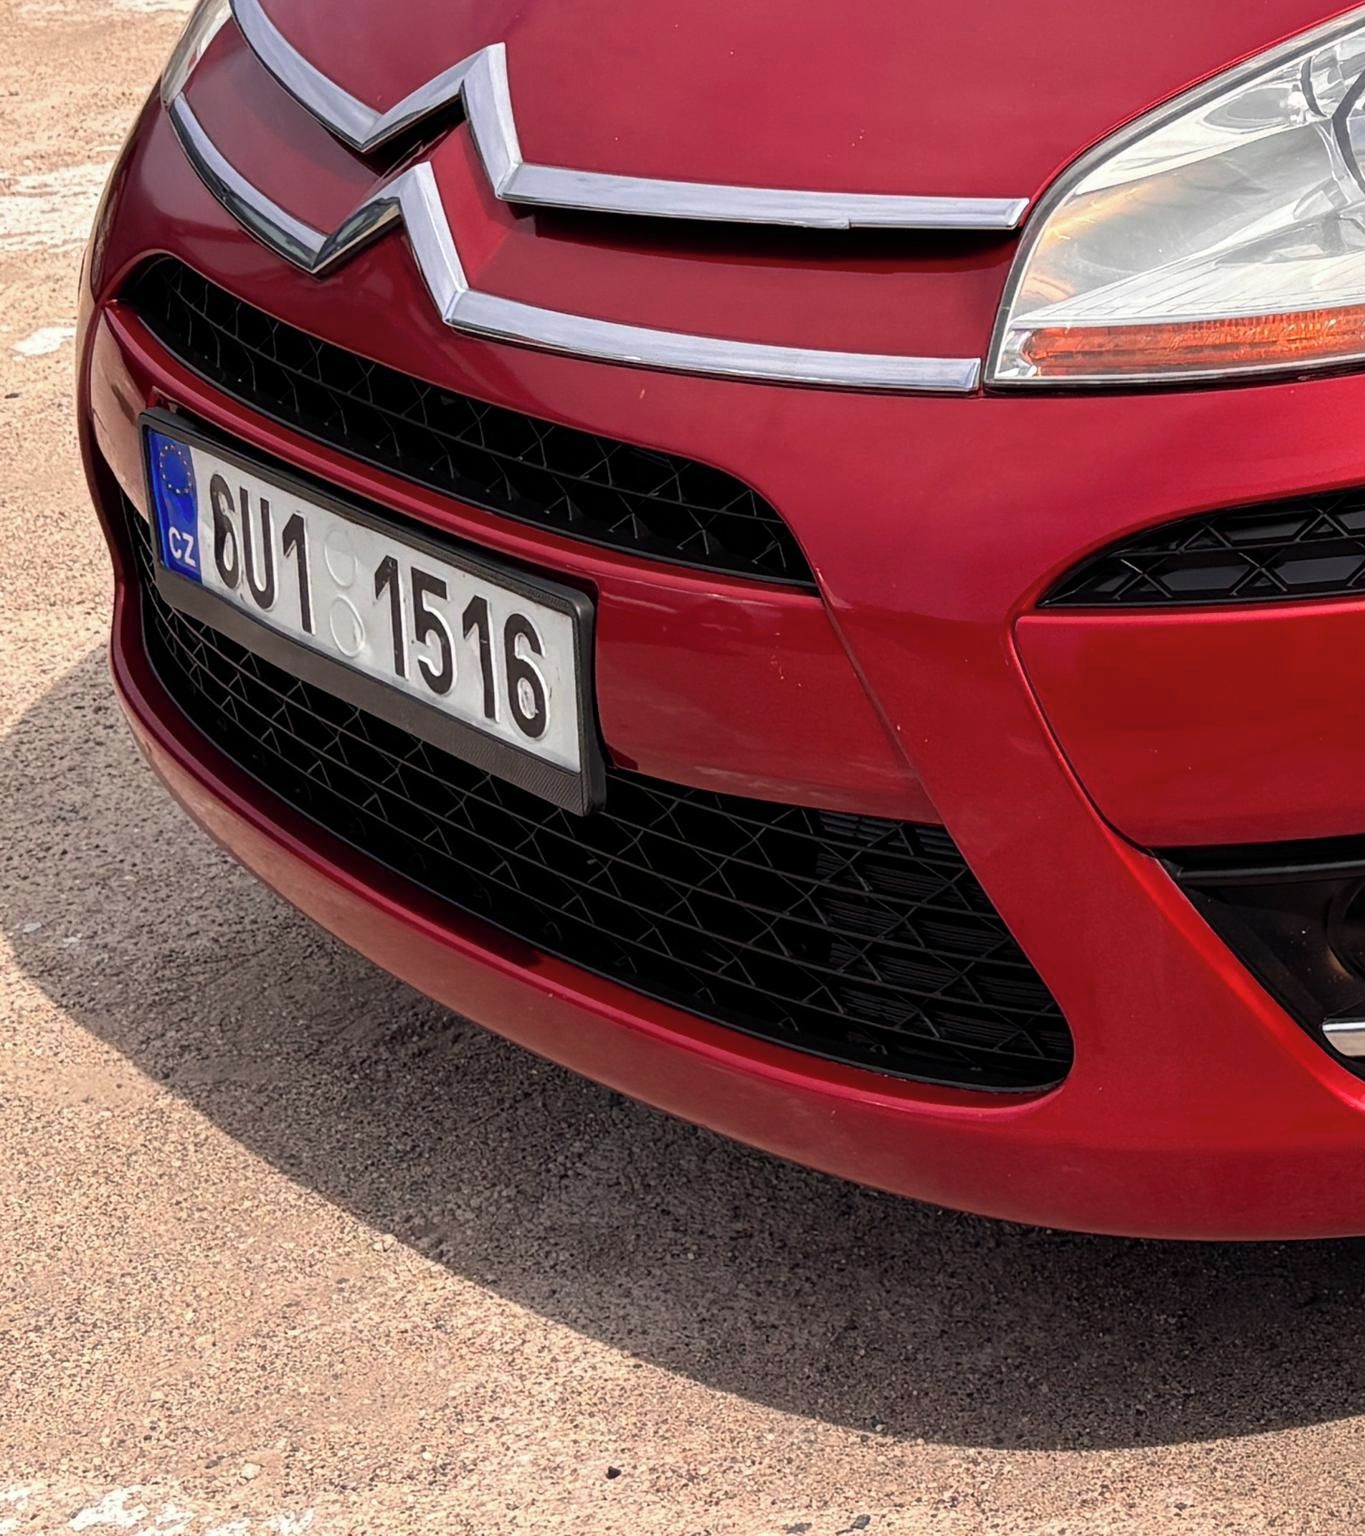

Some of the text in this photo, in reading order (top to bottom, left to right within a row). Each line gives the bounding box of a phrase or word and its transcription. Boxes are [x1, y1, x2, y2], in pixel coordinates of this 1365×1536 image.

[168, 526, 197, 566] CZ
[210, 472, 550, 740] 6U1 1516
